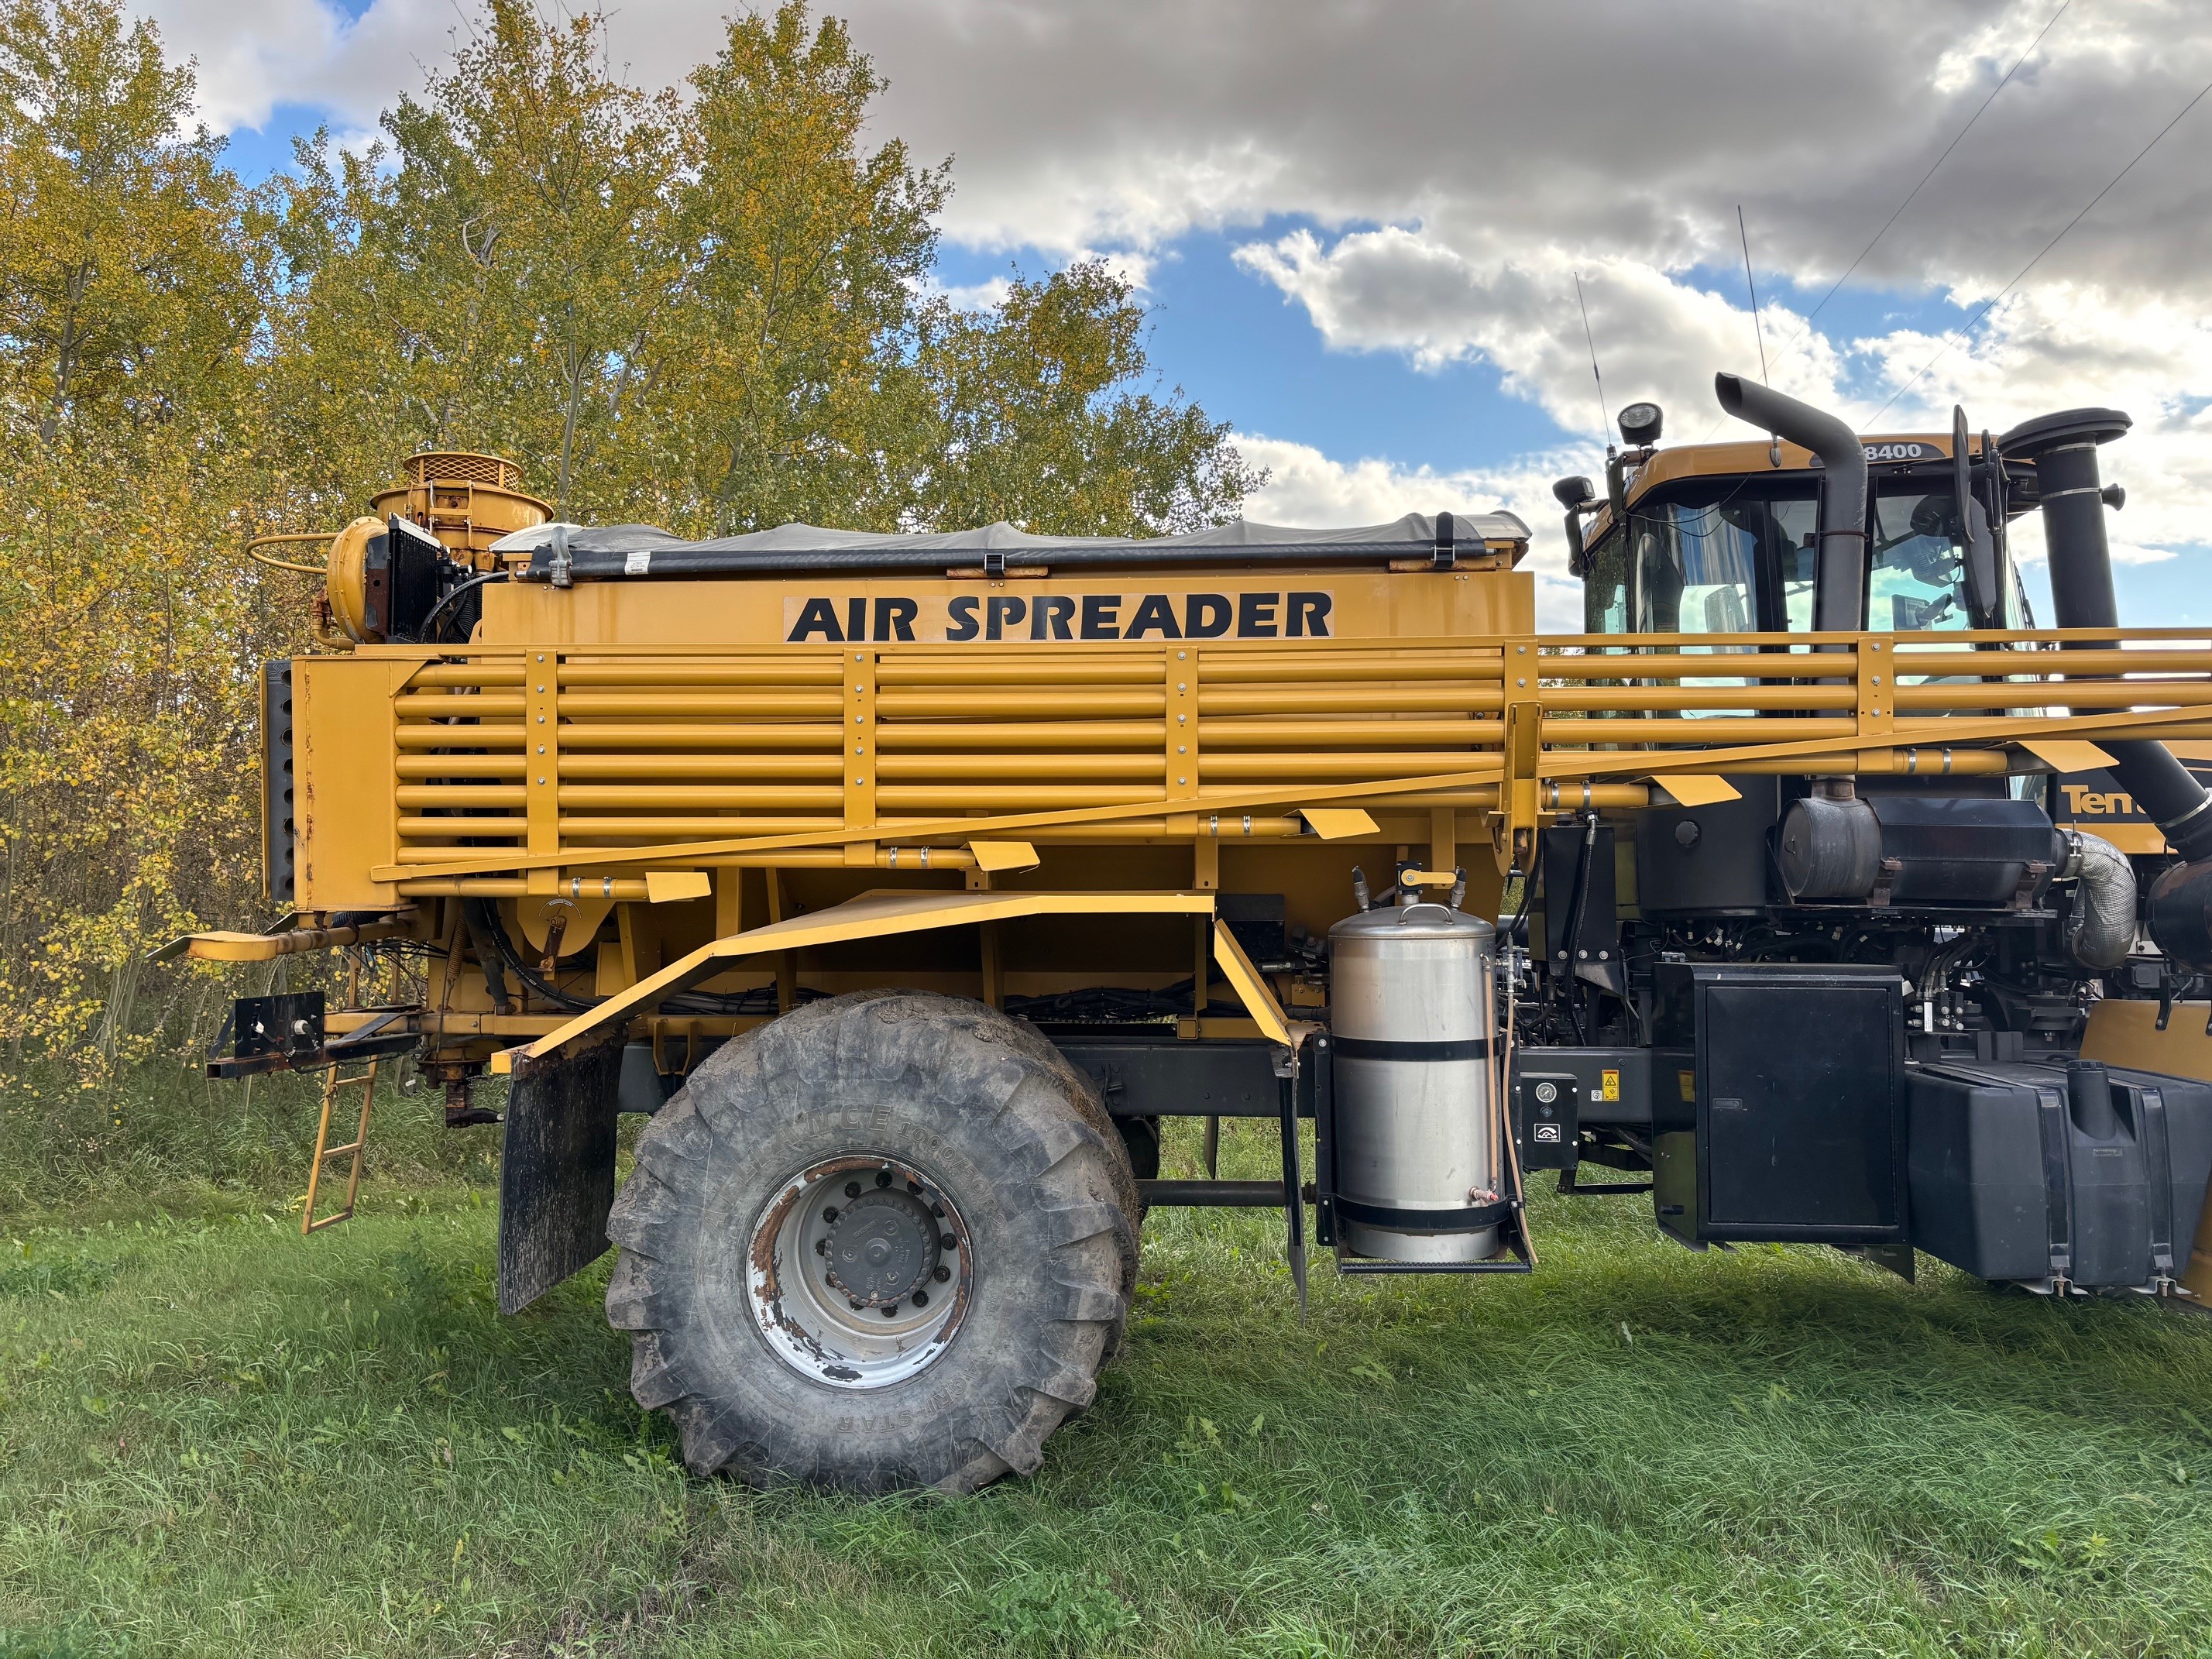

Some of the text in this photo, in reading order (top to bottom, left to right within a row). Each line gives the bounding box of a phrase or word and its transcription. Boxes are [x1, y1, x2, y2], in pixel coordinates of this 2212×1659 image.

[1863, 444, 1922, 460] 8400
[787, 592, 1332, 641] AIR SPREADER
[2061, 785, 2146, 814] Terr
[702, 1104, 891, 1238] ALLIANCE
[836, 1359, 981, 1433] AGRI-STAR
